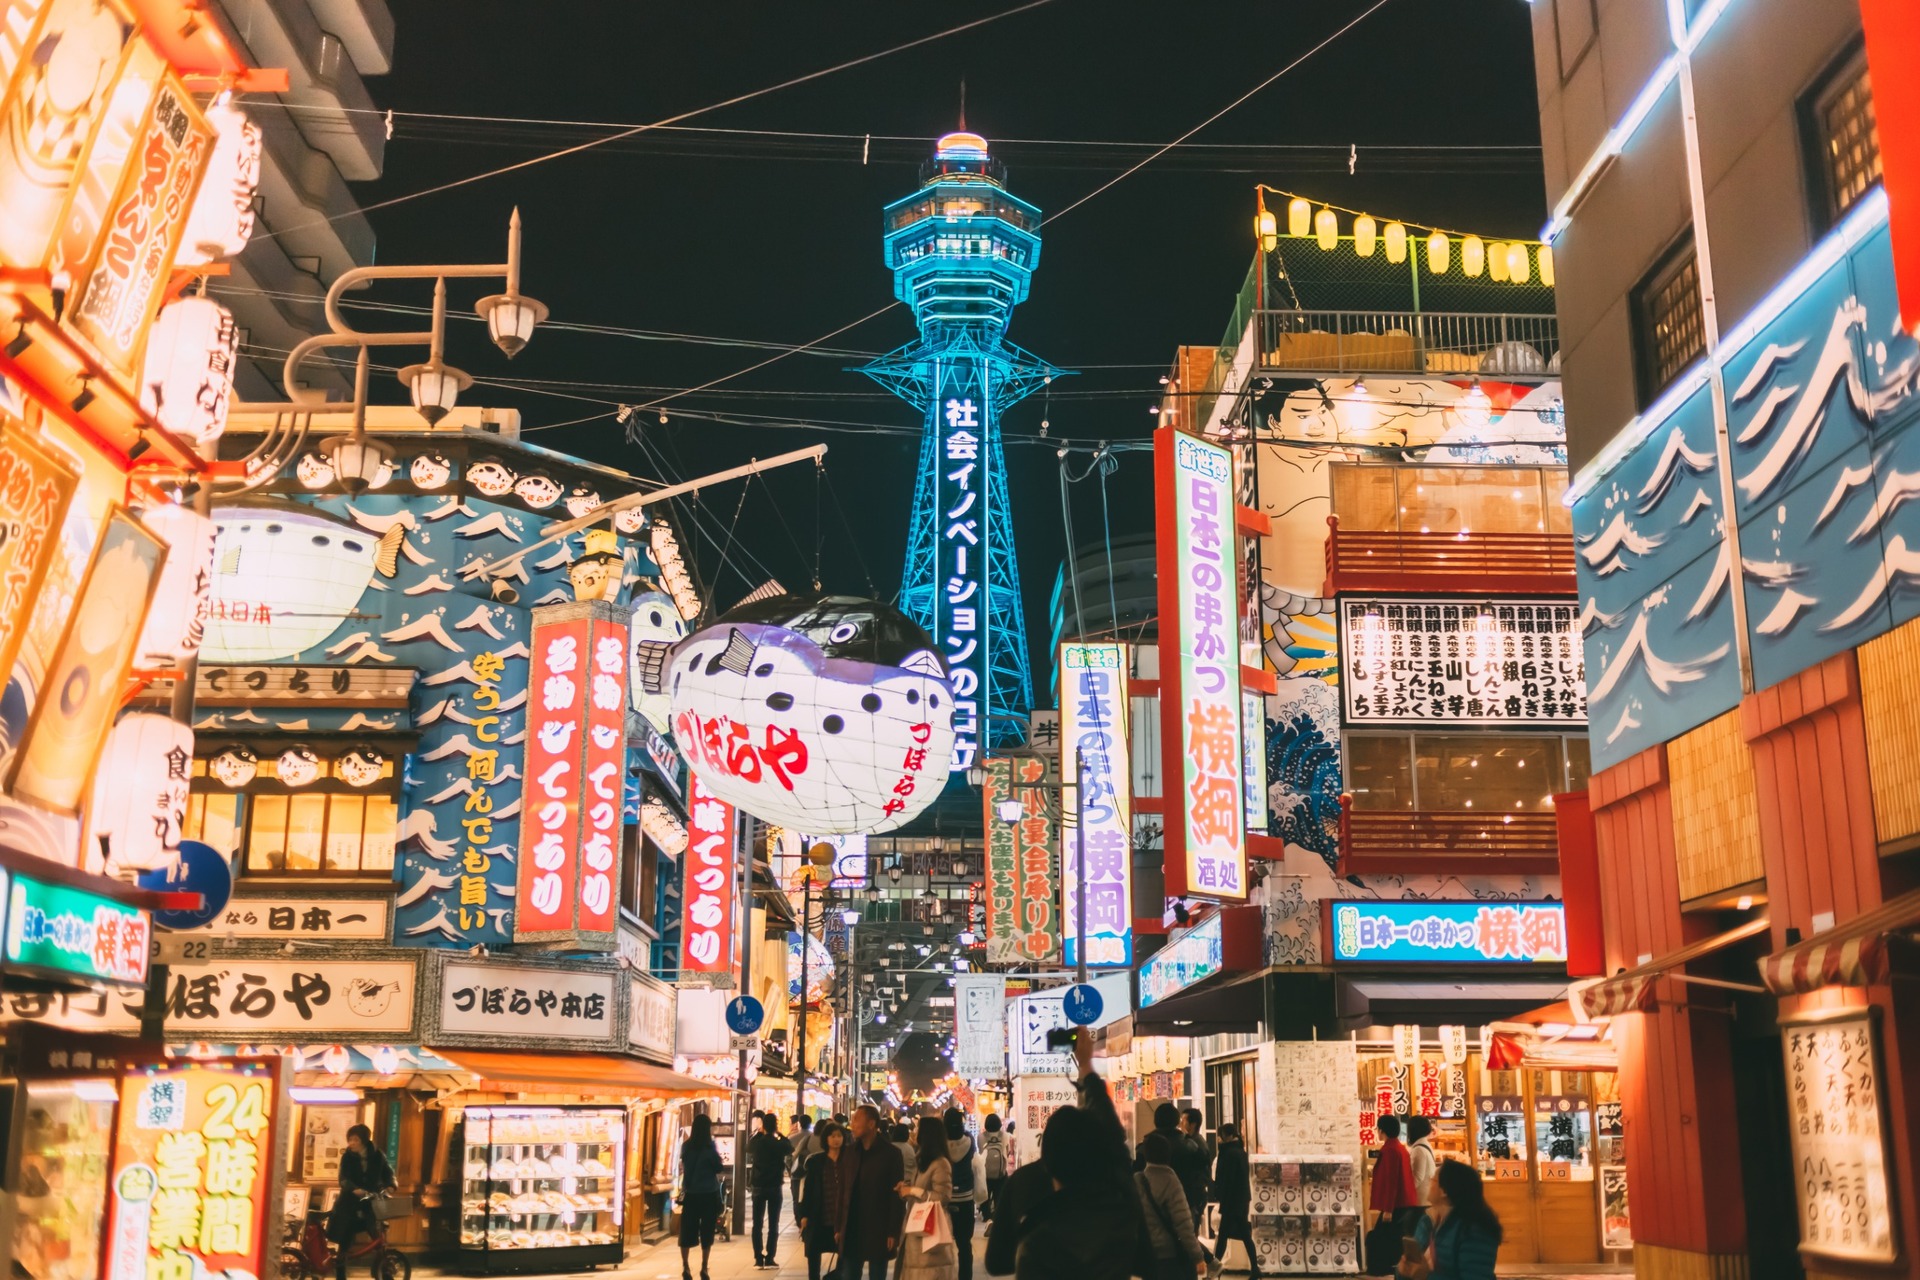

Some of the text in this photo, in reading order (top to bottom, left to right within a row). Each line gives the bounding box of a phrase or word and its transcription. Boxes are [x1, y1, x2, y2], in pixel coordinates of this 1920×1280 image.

[1178, 439, 1229, 484] 新世界
[1188, 477, 1228, 694] 日本一の串かつ
[543, 635, 578, 712] 名物
[592, 635, 623, 712] 名物
[1352, 660, 1370, 716] もち
[1390, 660, 1410, 716] 紅しょうが
[1407, 660, 1427, 717] にんにく
[1427, 660, 1447, 717] 玉ねぎ
[1446, 660, 1465, 717] 山芋
[1465, 661, 1484, 717] しし唐
[1484, 661, 1503, 717] れんこん
[1521, 661, 1540, 717] 白ねぎ
[1540, 661, 1559, 717] さつま芋
[882, 720, 935, 818] づぼらや
[1077, 671, 1114, 825] 日本一の串かつ
[1187, 699, 1239, 851] 横綱
[1021, 760, 1052, 959] 大小宴会承り中
[1069, 830, 1127, 934] 横綱
[1197, 856, 1239, 891] 酒処
[183, 941, 207, 959] 22
[1360, 917, 1475, 948] 日本一の串かつ
[1477, 907, 1563, 956] 横綱
[452, 985, 606, 1020] づぼらや本店
[1394, 1066, 1408, 1113] ソースの
[1420, 1060, 1441, 1117] お座敷
[1359, 1112, 1376, 1146] 御免
[1501, 1169, 1521, 1178] 入口
[1547, 1169, 1566, 1178] 入口
